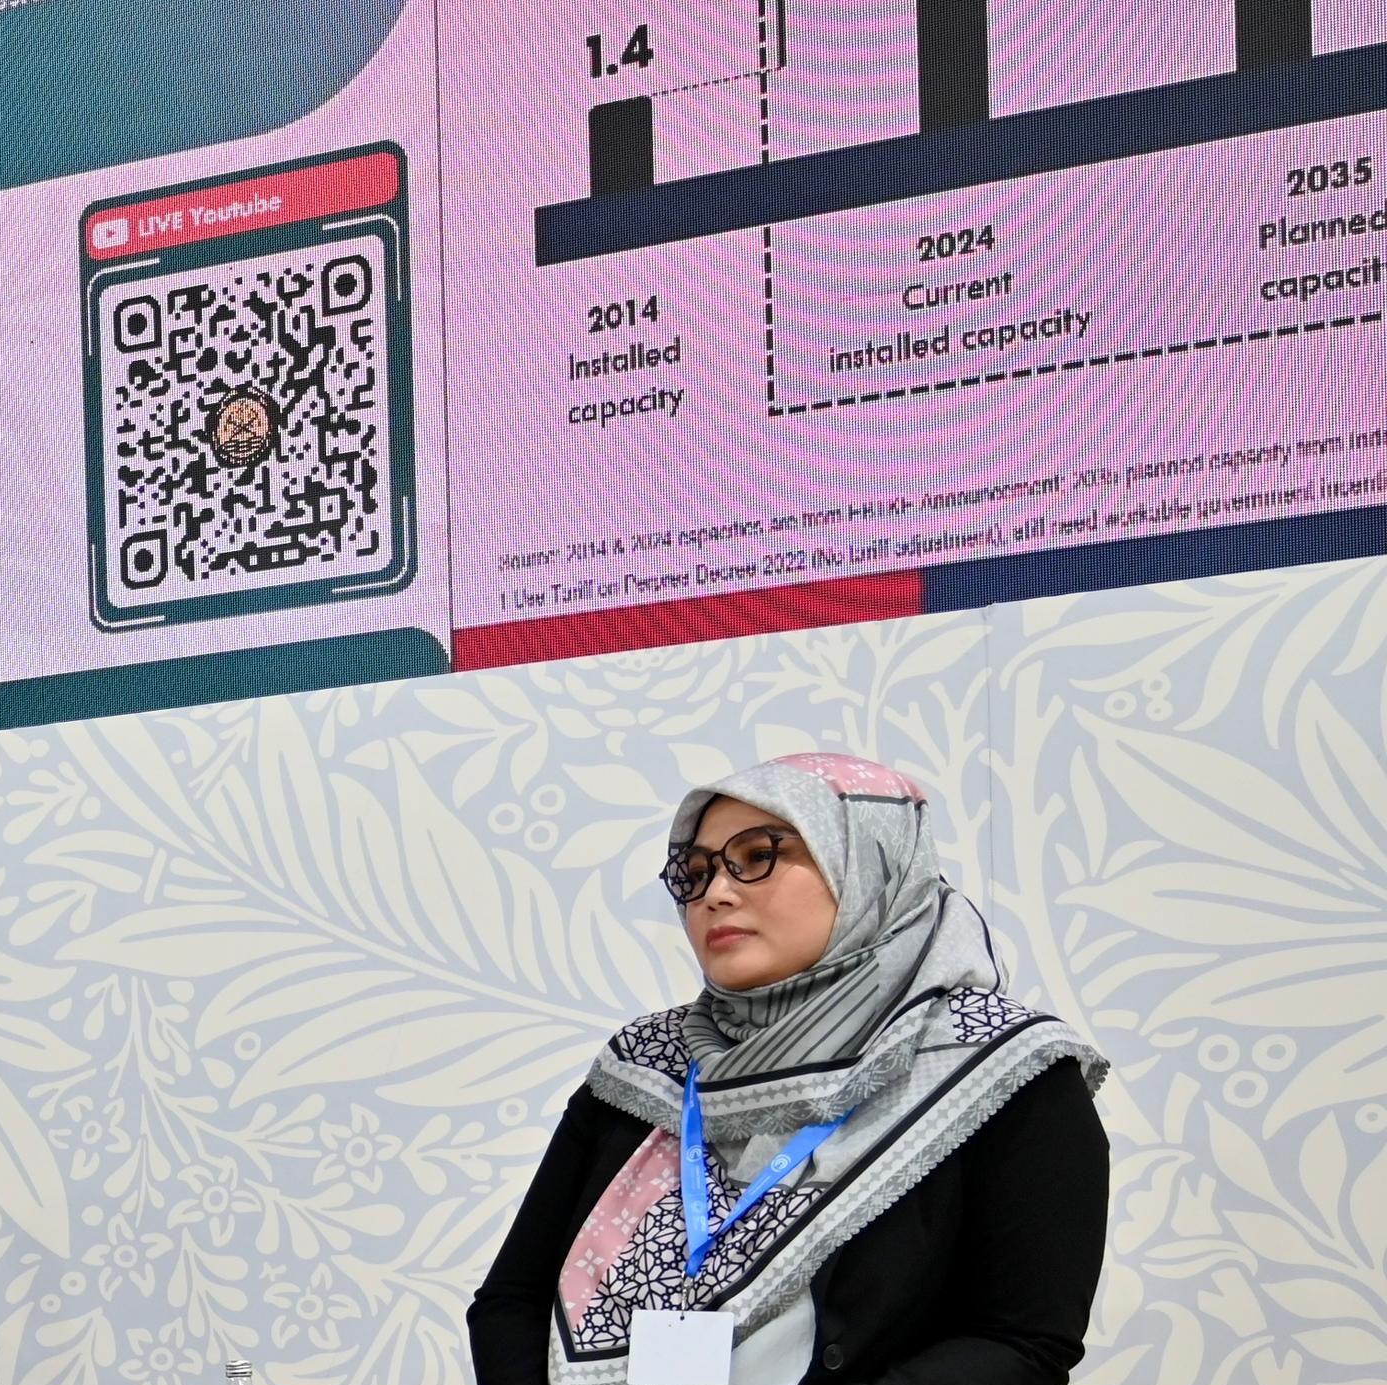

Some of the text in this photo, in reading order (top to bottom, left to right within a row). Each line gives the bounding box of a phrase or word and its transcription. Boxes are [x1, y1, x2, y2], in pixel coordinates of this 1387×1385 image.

[586, 24, 654, 78] 1.4
[1286, 156, 1372, 197] 2035
[138, 193, 283, 237] LIVE Youtube
[916, 224, 995, 262] 2024
[902, 272, 1013, 311] Current
[1260, 254, 1387, 302] capacit
[587, 295, 659, 334] 2014
[569, 335, 681, 381] Installed
[830, 308, 1091, 373] installed capacity
[568, 386, 685, 429] capacity
